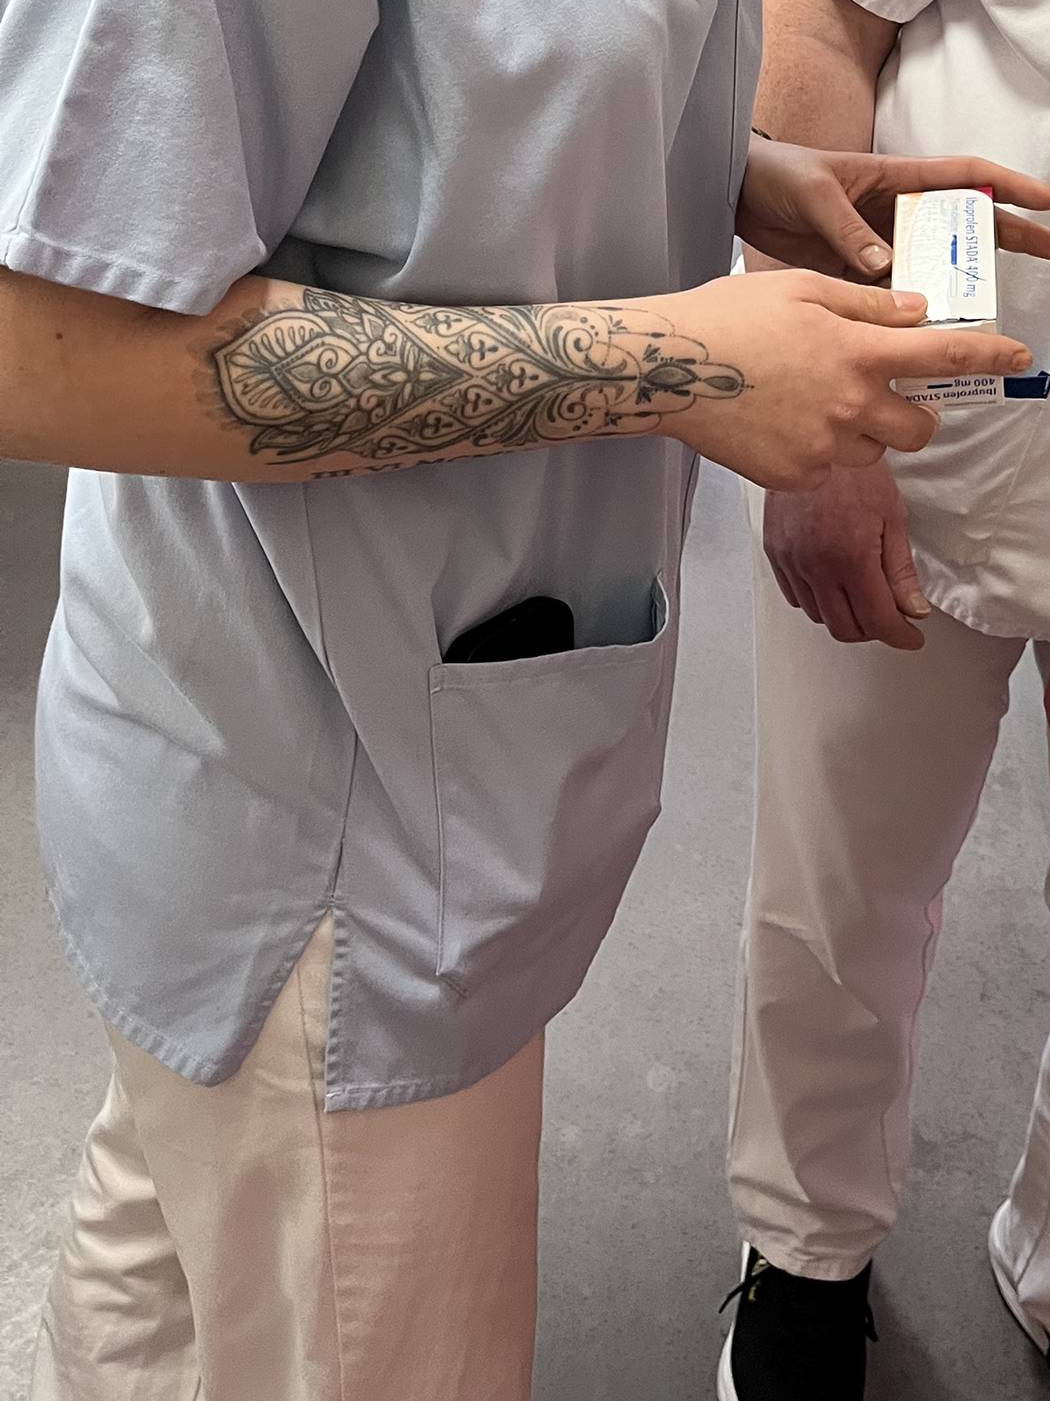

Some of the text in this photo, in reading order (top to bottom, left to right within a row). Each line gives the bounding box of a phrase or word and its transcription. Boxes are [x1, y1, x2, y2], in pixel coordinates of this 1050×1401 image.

[966, 235, 979, 264] STADA
[953, 378, 995, 387] 400 mg
[943, 387, 997, 400] Ibuprofen
